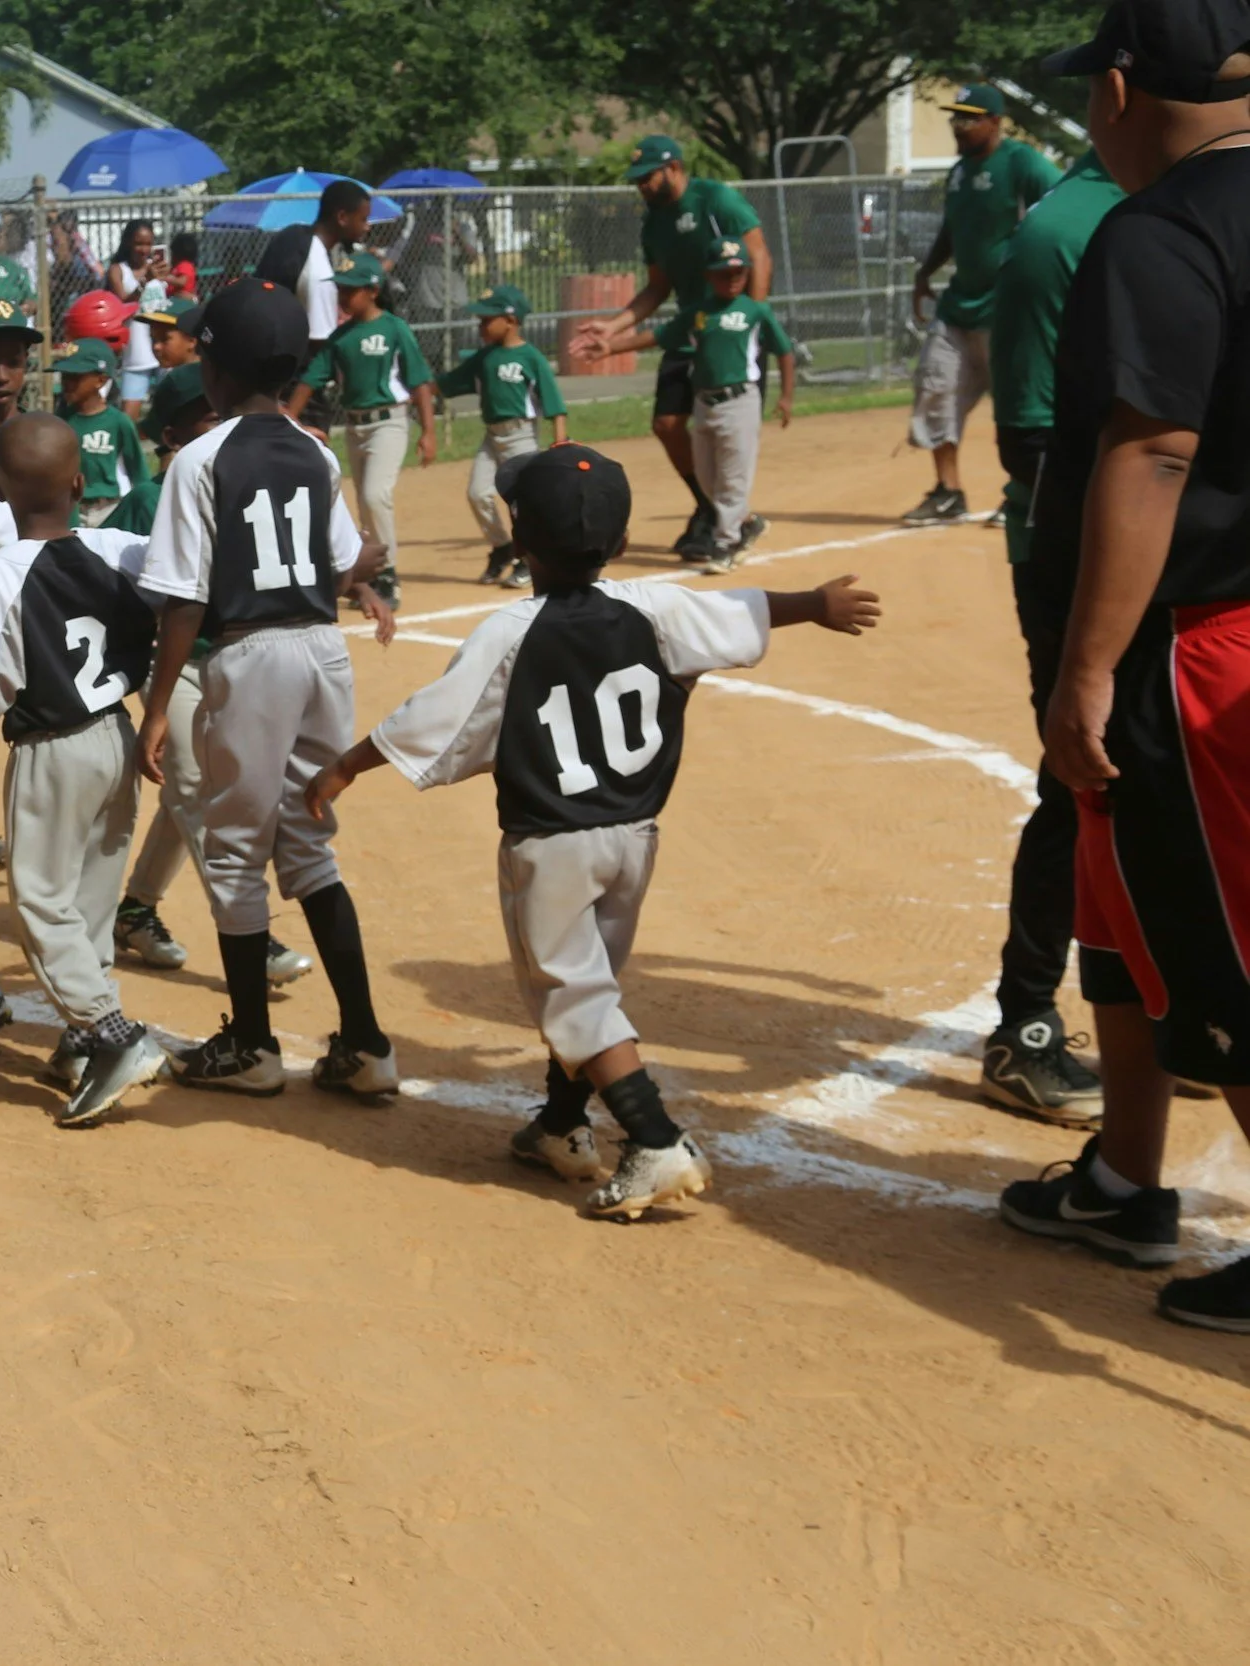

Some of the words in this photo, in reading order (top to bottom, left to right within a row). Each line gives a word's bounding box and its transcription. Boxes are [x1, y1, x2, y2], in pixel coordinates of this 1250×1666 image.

[360, 334, 389, 352] NL
[82, 430, 114, 450] NL
[243, 487, 316, 590] 11
[65, 617, 129, 713] 2
[538, 664, 663, 795] 10
